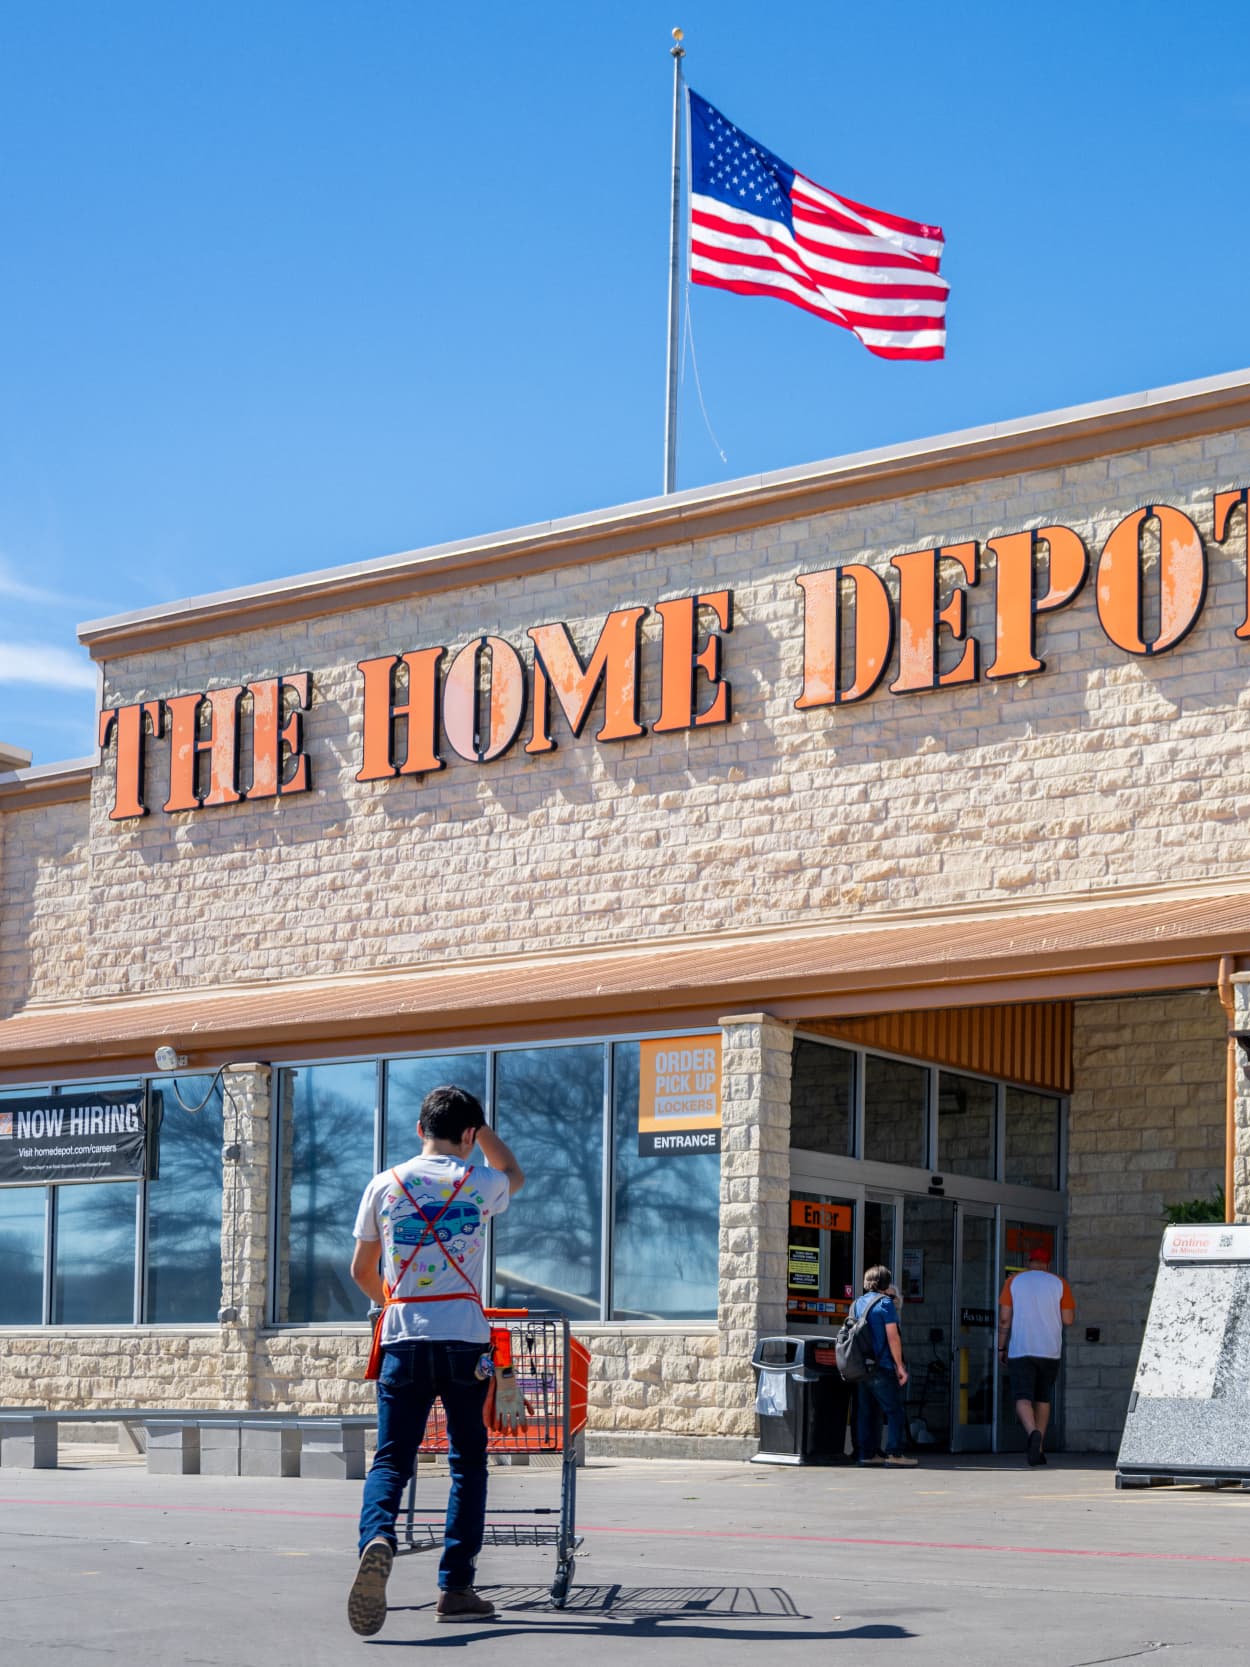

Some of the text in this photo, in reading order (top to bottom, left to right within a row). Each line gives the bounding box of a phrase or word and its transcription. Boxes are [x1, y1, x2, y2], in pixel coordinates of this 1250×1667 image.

[99, 671, 313, 822] THE
[355, 589, 733, 783] HOME
[655, 1048, 716, 1075] ORDER
[655, 1072, 717, 1094] PICK UP
[657, 1098, 714, 1114] LOCKERS
[17, 1108, 64, 1139] NOW
[70, 1103, 139, 1136] HIRING
[18, 1143, 117, 1158] Visit homedepot.com/careers
[654, 1134, 716, 1149] ENTRANCE
[804, 1205, 839, 1227] Enter
[1172, 1237, 1210, 1247] Online
